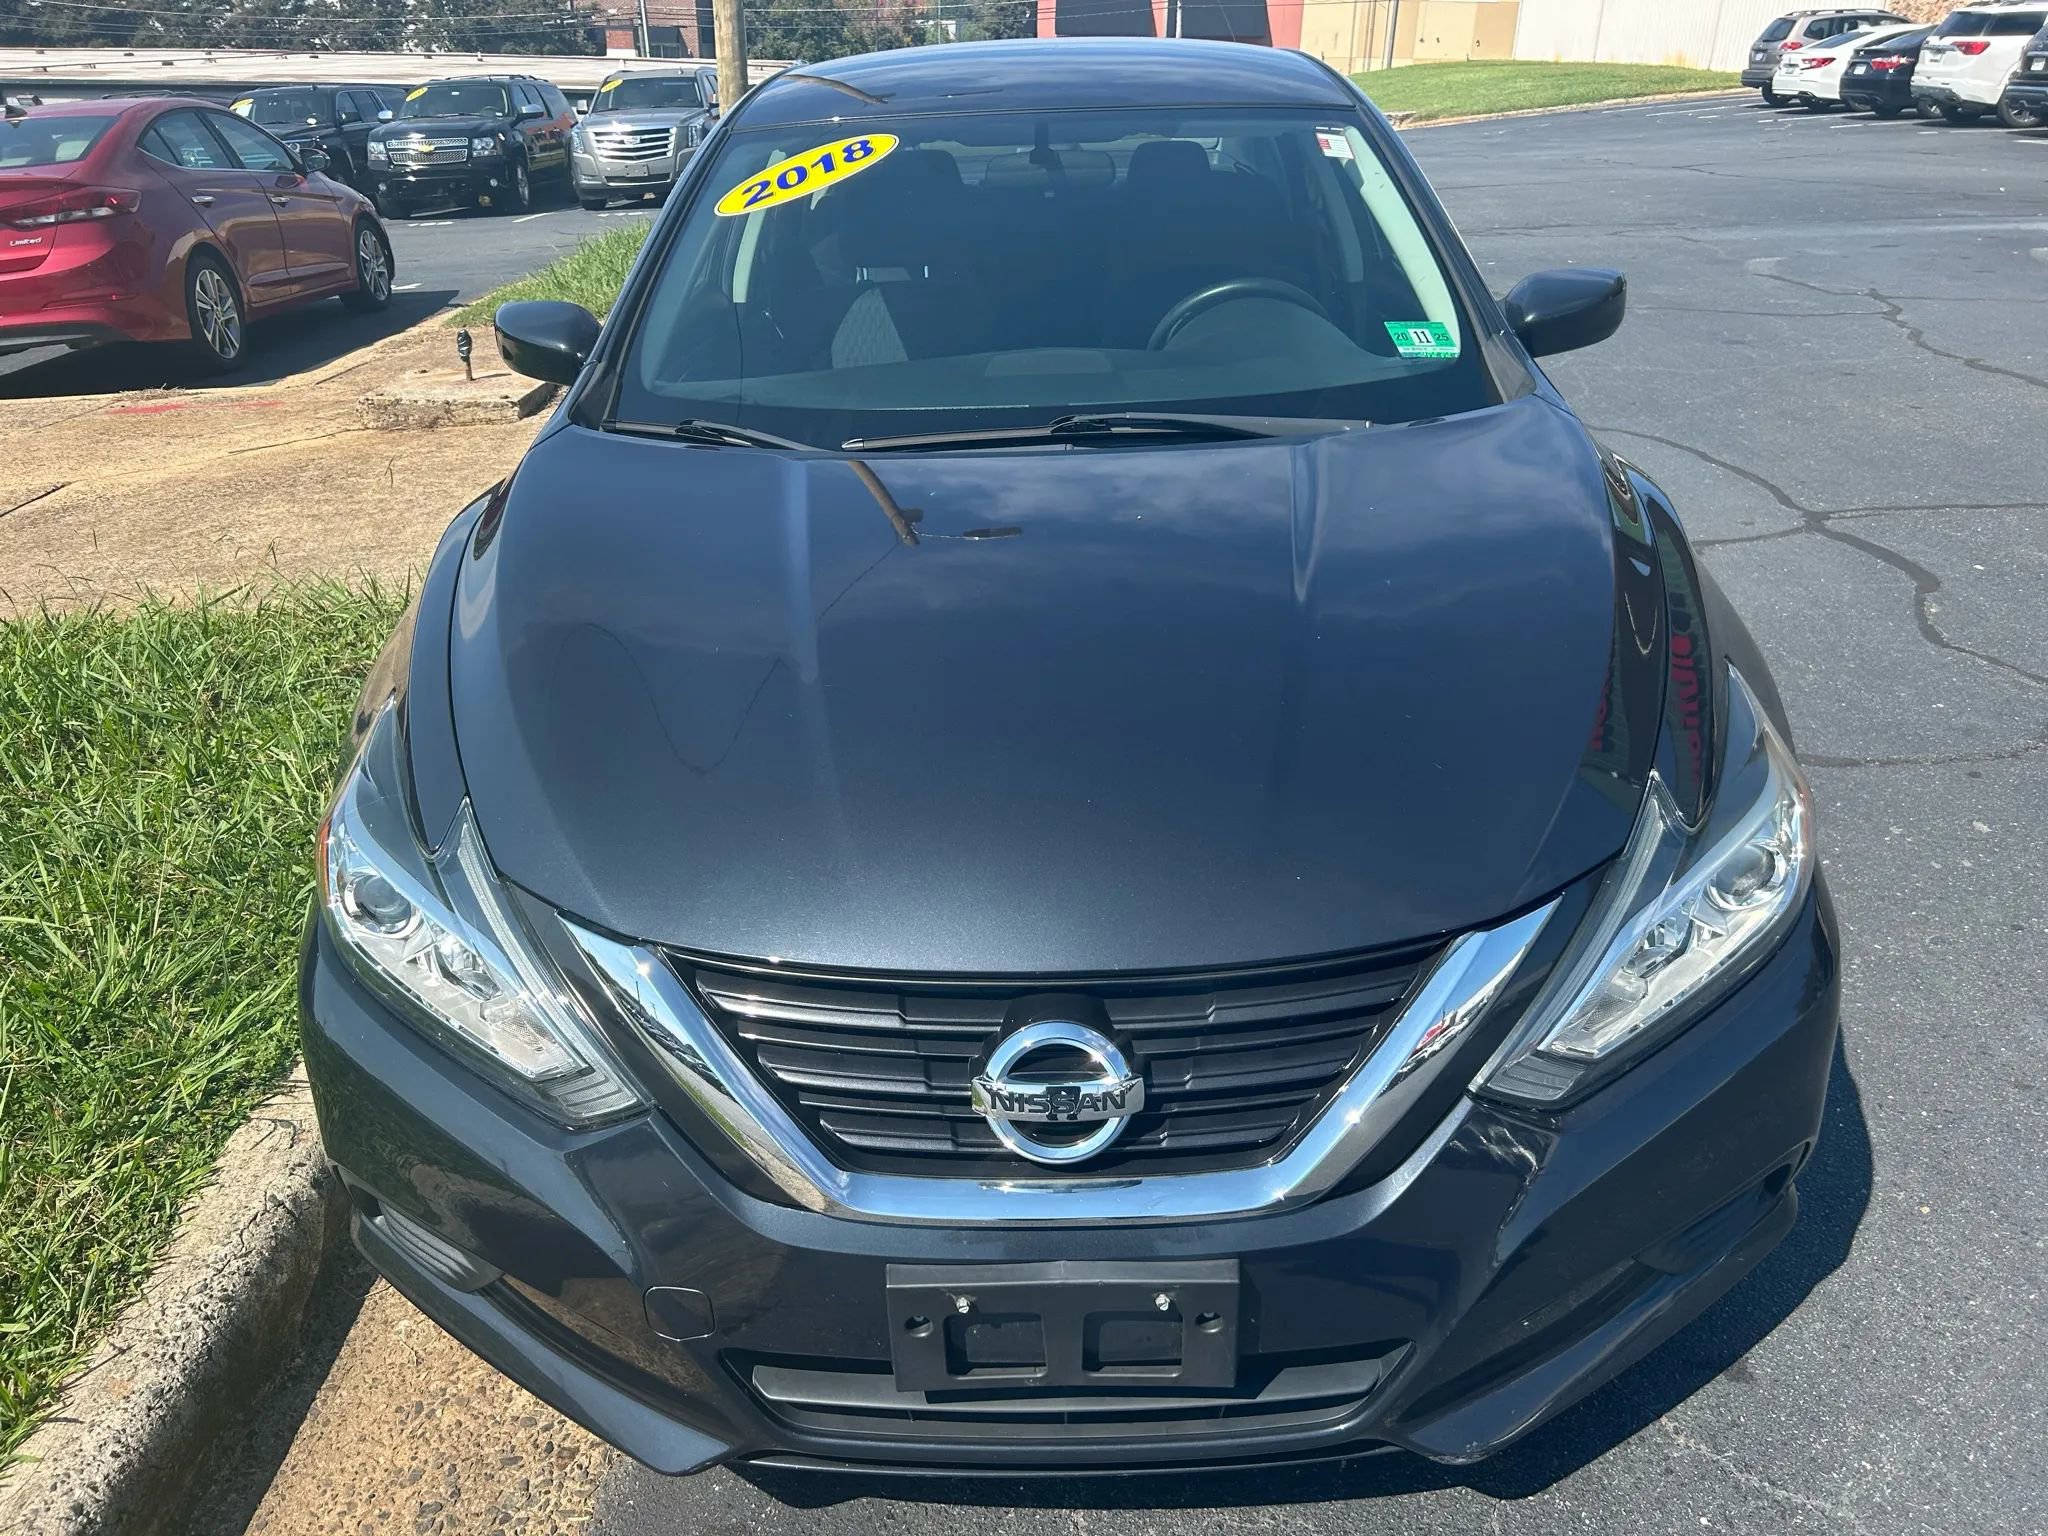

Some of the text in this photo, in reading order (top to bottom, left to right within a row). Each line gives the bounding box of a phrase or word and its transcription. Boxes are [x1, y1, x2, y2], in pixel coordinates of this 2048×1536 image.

[742, 139, 875, 209] 2018
[1394, 330, 1450, 344] 20 11 25
[990, 1089, 1126, 1115] NISSAN
